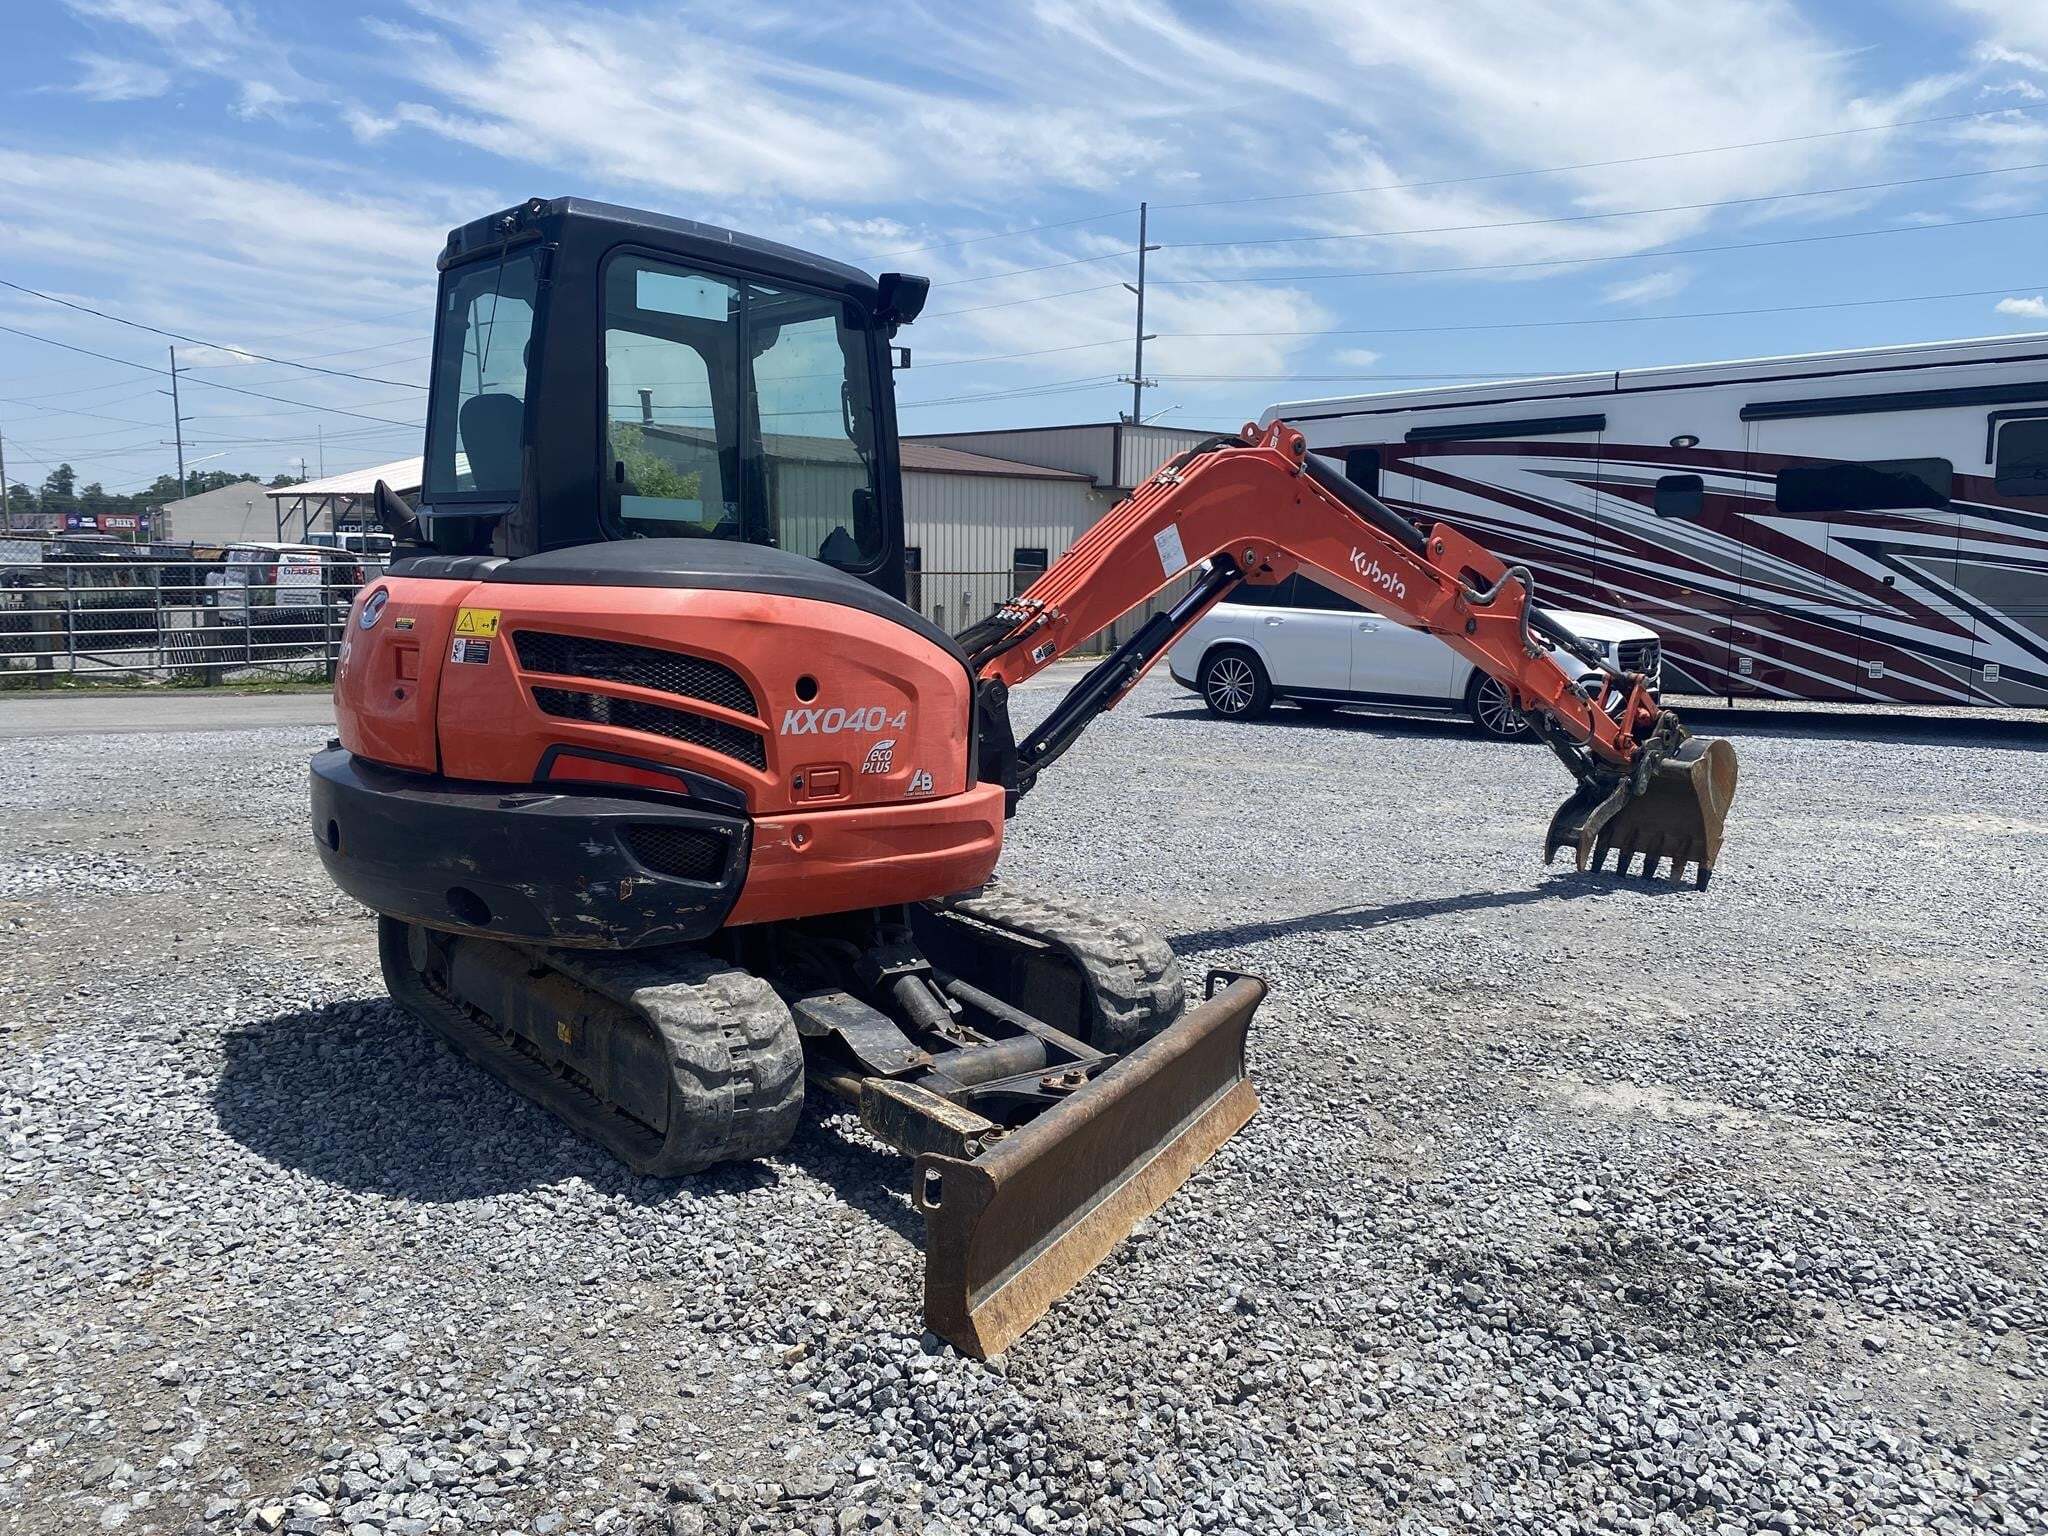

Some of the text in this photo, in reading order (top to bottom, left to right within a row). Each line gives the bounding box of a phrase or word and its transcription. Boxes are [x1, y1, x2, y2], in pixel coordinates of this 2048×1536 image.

[1349, 546, 1406, 600] Kubota
[780, 705, 908, 736] KX040-4
[870, 750, 893, 762] eco
[861, 761, 892, 774] PLUS
